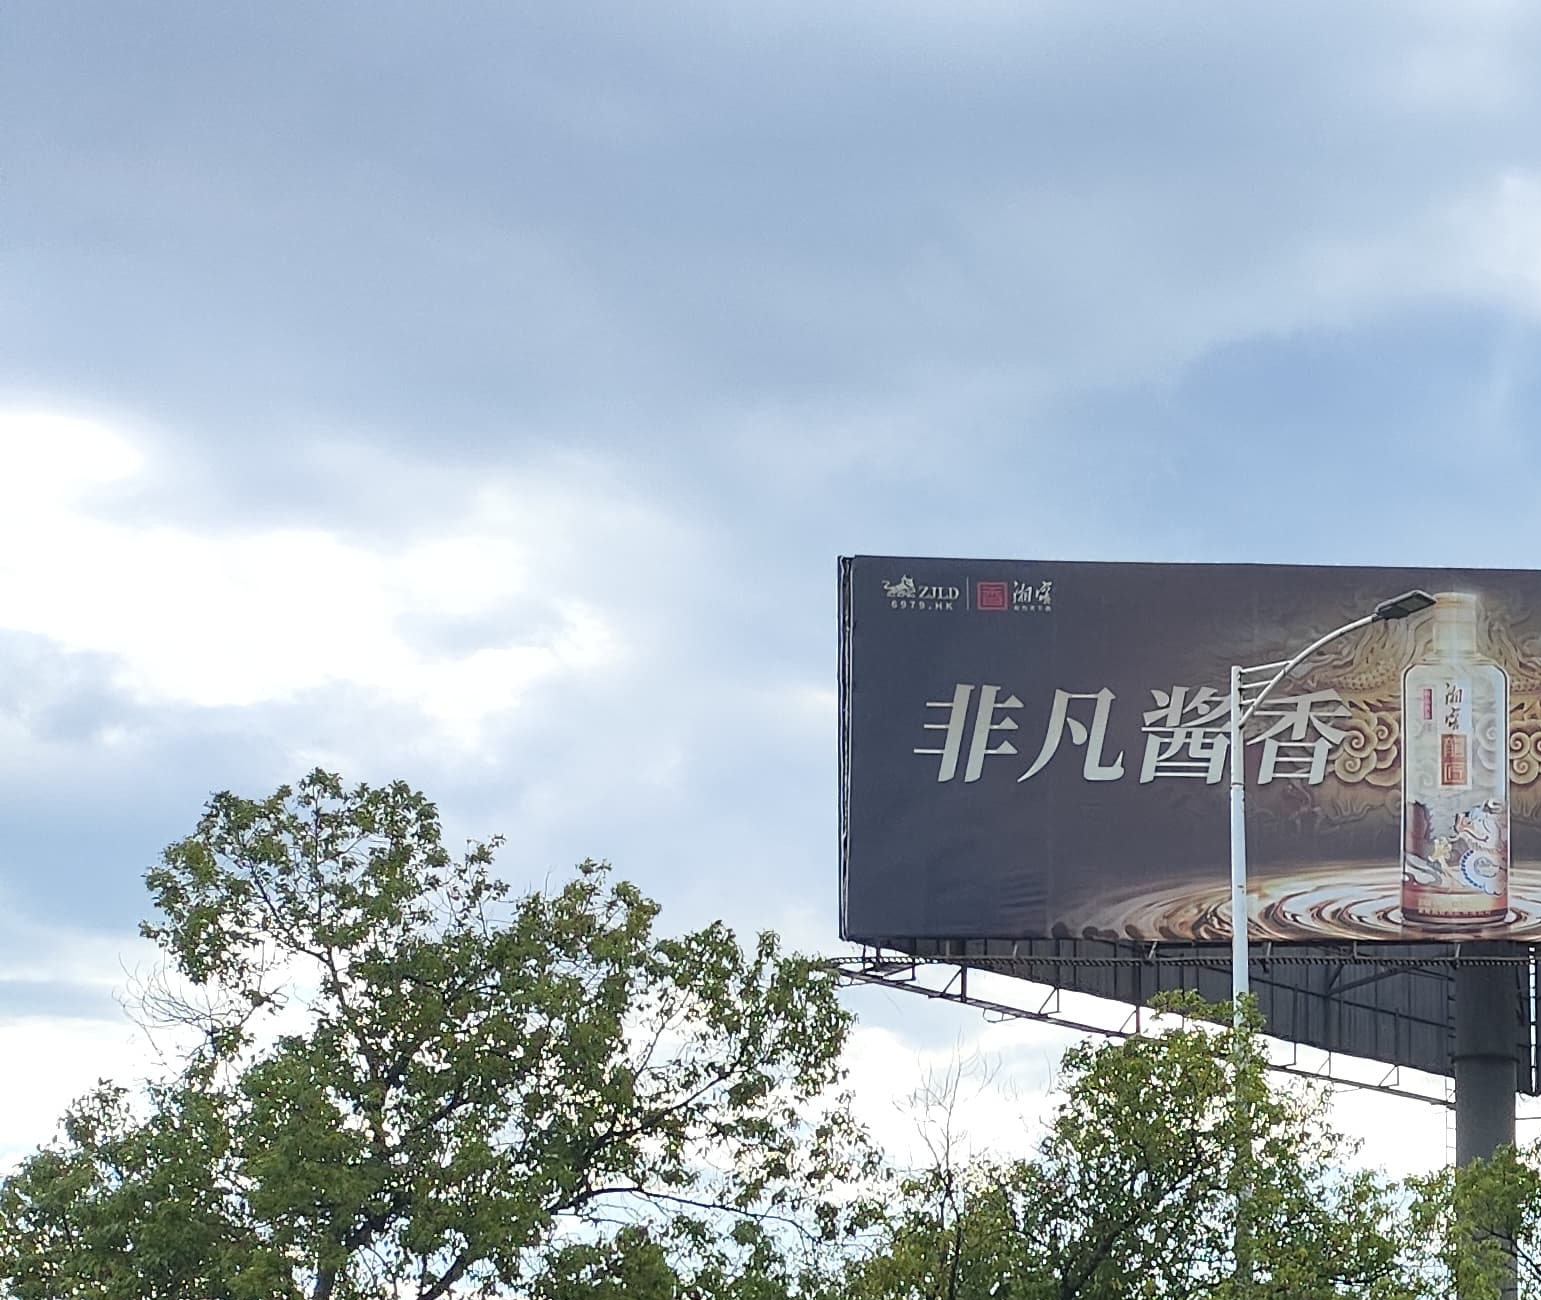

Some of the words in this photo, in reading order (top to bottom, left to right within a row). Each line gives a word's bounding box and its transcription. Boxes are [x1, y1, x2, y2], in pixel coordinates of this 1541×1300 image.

[918, 585, 960, 600] ZJLD
[890, 600, 954, 611] 6979.HK
[913, 684, 1353, 785] 非凡酱香
